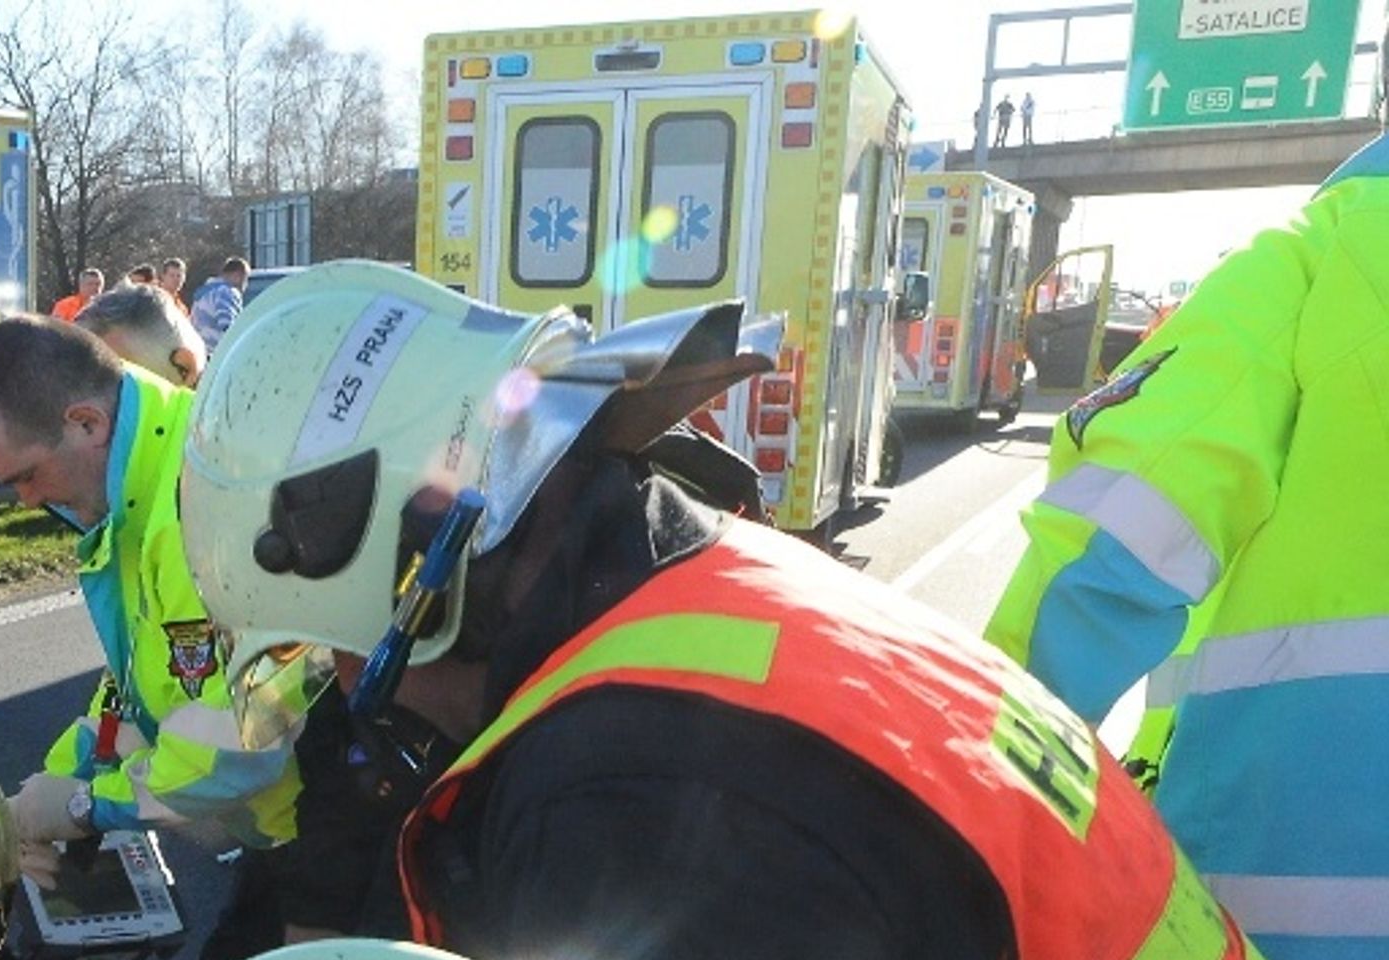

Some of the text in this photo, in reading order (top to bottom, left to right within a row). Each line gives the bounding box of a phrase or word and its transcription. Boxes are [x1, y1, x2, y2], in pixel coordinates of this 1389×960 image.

[1208, 91, 1228, 108] 55
[440, 252, 471, 273] 154
[328, 308, 405, 422] HZS PRAHA
